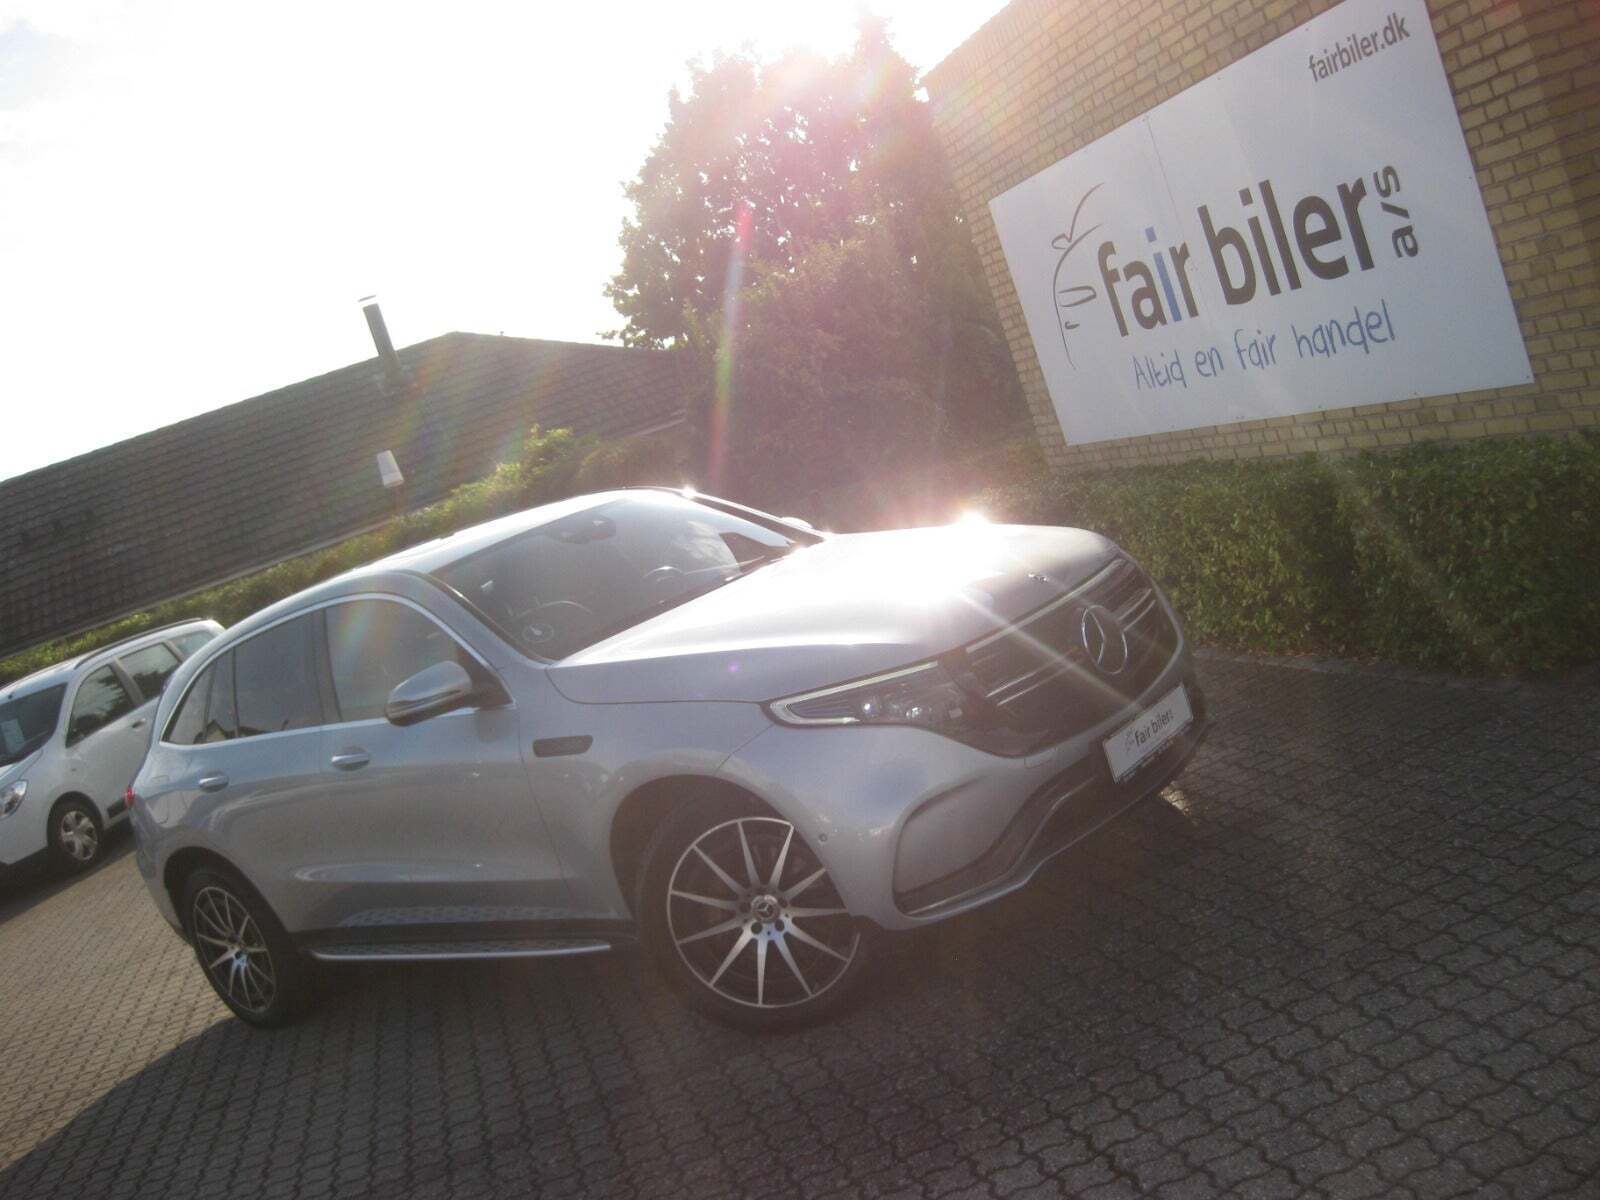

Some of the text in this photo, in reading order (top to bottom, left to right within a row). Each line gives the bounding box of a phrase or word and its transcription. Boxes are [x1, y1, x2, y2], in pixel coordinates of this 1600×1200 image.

[1308, 12, 1410, 83] fairbiler.dk
[1374, 165, 1419, 258] a/s
[1098, 179, 1375, 337] fair biler
[1132, 299, 1396, 390] Altid en fair handel
[1134, 726, 1152, 746] fair
[1151, 711, 1170, 733] biler
